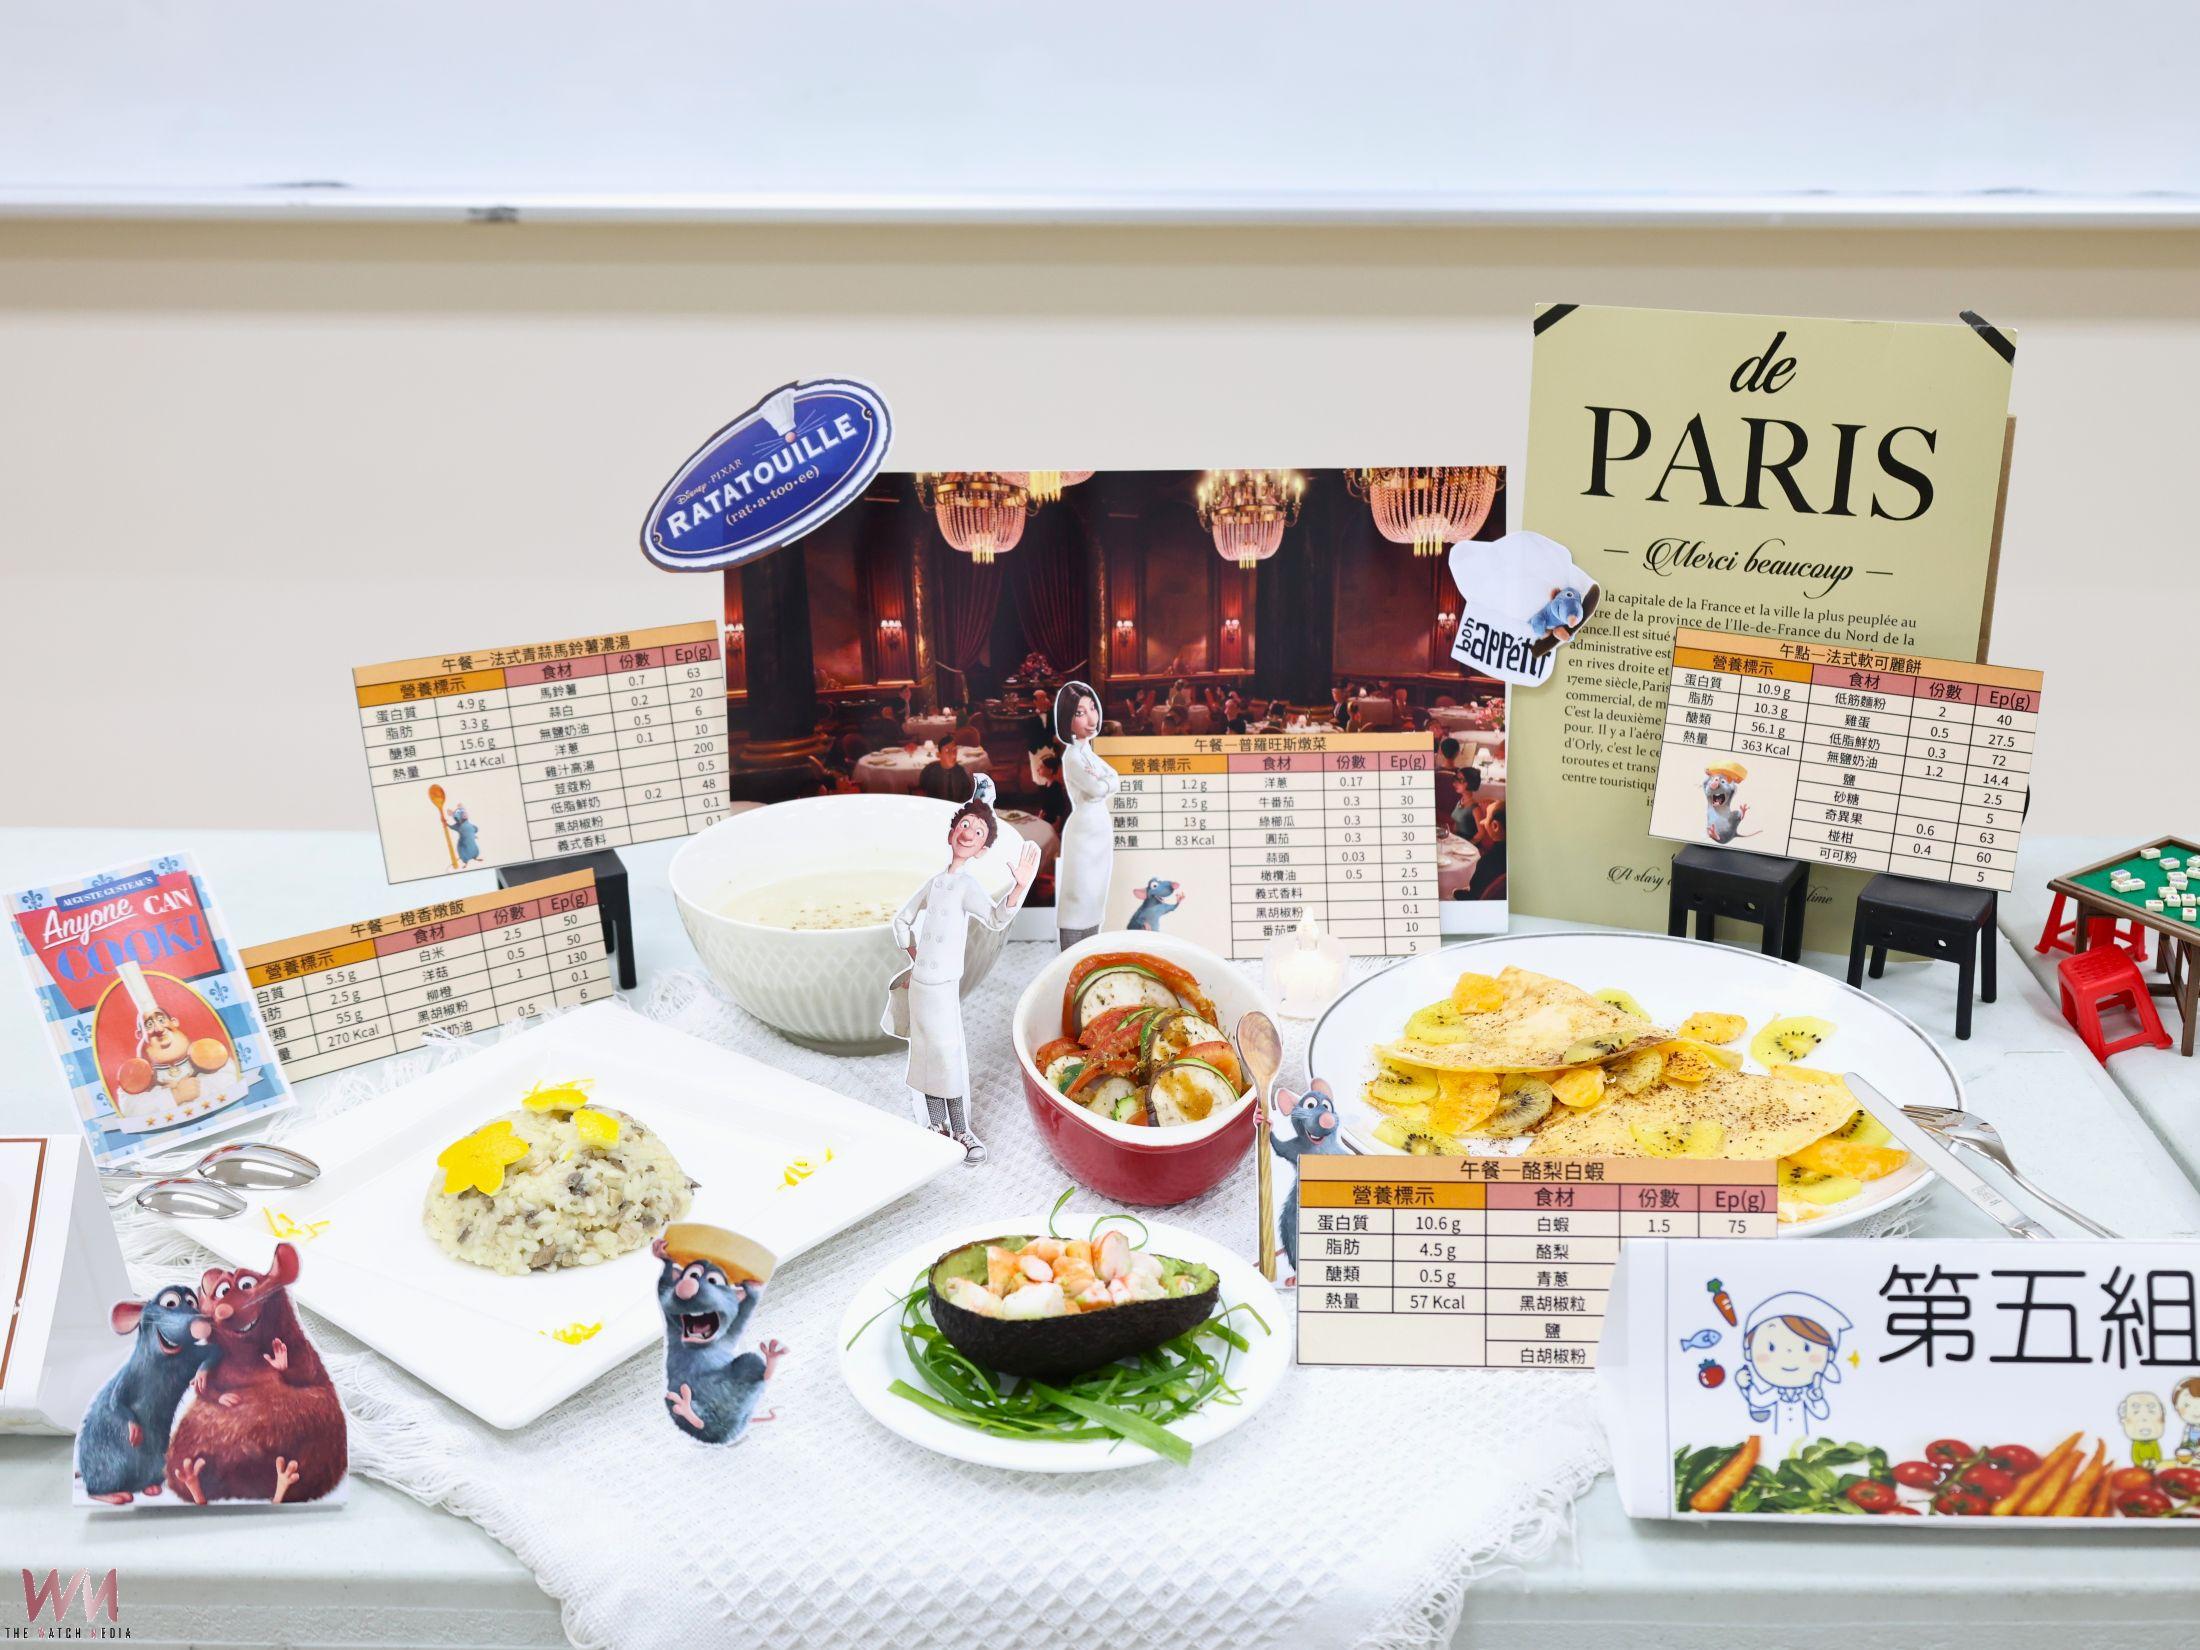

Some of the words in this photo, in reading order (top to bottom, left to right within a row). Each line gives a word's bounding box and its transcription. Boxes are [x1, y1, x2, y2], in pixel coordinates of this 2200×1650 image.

[1730, 331, 1797, 393] de
[710, 458, 743, 484] PIXAR
[1580, 405, 1937, 522] PARIS
[666, 413, 857, 539] RATATOUILLE
[1643, 538, 1738, 575] Merci
[1744, 538, 1854, 599] beaucoup
[1605, 590, 1614, 602] la
[1619, 594, 1665, 608] capitale
[1669, 596, 1683, 609] de
[1687, 597, 1696, 610] la
[1701, 600, 1740, 613] France
[1745, 606, 1756, 615] et
[1760, 604, 1770, 616] la
[1774, 606, 1800, 618] ville
[1804, 608, 1814, 620] la
[1818, 610, 1844, 623] plus
[1849, 614, 1898, 627] peuplée
[1901, 619, 1916, 628] au
[1615, 608, 1629, 620] de
[1634, 609, 1644, 621] la
[1648, 614, 1702, 628] province
[1707, 617, 1721, 629] de
[1825, 627, 1840, 640] du
[1846, 630, 1878, 643] Nord
[1884, 631, 1899, 644] de
[1904, 633, 1915, 646] la
[1624, 629, 1638, 638] est
[1642, 631, 1670, 641] situé
[675, 643, 712, 663] Ep(g)
[1570, 639, 1652, 656] administrative
[1655, 650, 1671, 658] est
[619, 651, 650, 669] 份數
[1568, 658, 1582, 667] en
[1588, 658, 1614, 670] rives
[1618, 662, 1654, 675] droite
[1658, 666, 1670, 676] et
[1712, 654, 1774, 676] 營養標示
[541, 661, 572, 680] 食材
[686, 667, 701, 679] 63
[399, 677, 466, 699] 營養標示
[628, 674, 645, 687] 0.7
[1684, 673, 1722, 690] 蛋白質
[1848, 671, 1881, 690] 食材
[540, 683, 577, 699] 馬鈴薯
[1687, 691, 1714, 706] 脂肪
[1756, 682, 1781, 696] 10.9
[1780, 688, 1791, 701] g
[1929, 681, 1962, 700] 份數
[1638, 697, 1652, 708] de
[1987, 690, 2031, 712] Ep(g)
[375, 705, 417, 723] 蛋白質
[549, 704, 573, 718] 蒜白
[1595, 708, 1603, 719] la
[1607, 710, 1661, 725] deuxième
[1685, 710, 1711, 726] 醣類
[1844, 714, 1870, 729] 雞蛋
[1996, 714, 2012, 726] 40
[385, 725, 413, 740] 脂肪
[1683, 730, 1708, 745] 熱量
[1930, 726, 1949, 739] 0.5
[1987, 734, 2015, 748] 27.5
[1741, 739, 1762, 752] 363
[1765, 742, 1790, 756] Kcal
[1829, 732, 1880, 751] 低脂鮮奶
[1637, 745, 1646, 756] le
[1927, 746, 1946, 759] 0.3
[455, 758, 477, 771] 114
[479, 753, 505, 767] Kcal
[1131, 757, 1191, 773] 營養標示
[1262, 755, 1291, 771] 食材
[1336, 754, 1366, 770] 份數
[1390, 753, 1426, 770] Ep(g)
[1562, 755, 1609, 768] toroutes
[1613, 761, 1623, 770] et
[1826, 750, 1878, 769] 無鹽奶油
[1992, 754, 2006, 767] 72
[1562, 773, 1597, 784] centre
[1925, 765, 1943, 778] 1.2
[1983, 773, 2009, 787] 14.4
[1339, 776, 1363, 787] 0.17
[1401, 775, 1413, 786] 17
[550, 796, 600, 814] 低脂鮮奶
[1259, 796, 1294, 808] 牛番茄
[1833, 790, 1859, 806] 砂糖
[1983, 792, 2002, 806] 2.5
[1825, 808, 1863, 825] 奇異果
[1827, 828, 1854, 844] 椪柑
[1916, 823, 1934, 836] 0.6
[1979, 832, 1995, 844] 63
[1175, 835, 1188, 846] 83
[1191, 835, 1215, 846] Kcal
[1913, 842, 1931, 855] 0.4
[1266, 852, 1289, 863] 蒜頭
[1341, 851, 1365, 862] 0.03
[1819, 846, 1857, 864] 可可粉
[1976, 851, 1992, 864] 60
[550, 890, 589, 911] Ep(g)
[43, 898, 133, 946] Anyone
[143, 888, 193, 916] CAN
[493, 905, 526, 925] 份數
[412, 923, 445, 944] 食材
[503, 927, 522, 941] 2.5
[57, 914, 203, 982] COOK!
[418, 946, 445, 963] 白米
[264, 950, 334, 980] 營養標示
[567, 950, 587, 965] 130
[422, 965, 448, 982] 洋菇
[327, 1032, 350, 1047] 270
[352, 1023, 379, 1040] Kcal
[1352, 1184, 1434, 1206] 營養標示
[1534, 1187, 1575, 1207] 食材
[1638, 1188, 1680, 1208] 份數
[1713, 1189, 1767, 1213] Ep(g)
[1317, 1214, 1368, 1231] 蛋白質
[1415, 1216, 1447, 1230] 10.6
[1450, 1219, 1463, 1235] g
[1537, 1216, 1569, 1232] 白蝦
[1648, 1219, 1670, 1233] 1.5
[1728, 1219, 1746, 1234] 75
[1325, 1238, 1360, 1255] 脂肪
[1536, 1243, 1568, 1260] 酪梨
[1325, 1265, 1360, 1282] 醣類
[1325, 1292, 1359, 1309] 熱量
[1409, 1294, 1428, 1309] 57
[1433, 1295, 1465, 1309] Kcal
[1519, 1295, 1586, 1312] 黑胡椒粒
[1878, 1263, 2200, 1370] 第五組
[1545, 1322, 1560, 1339] 鹽
[1520, 1347, 1586, 1364] 白胡椒粉
